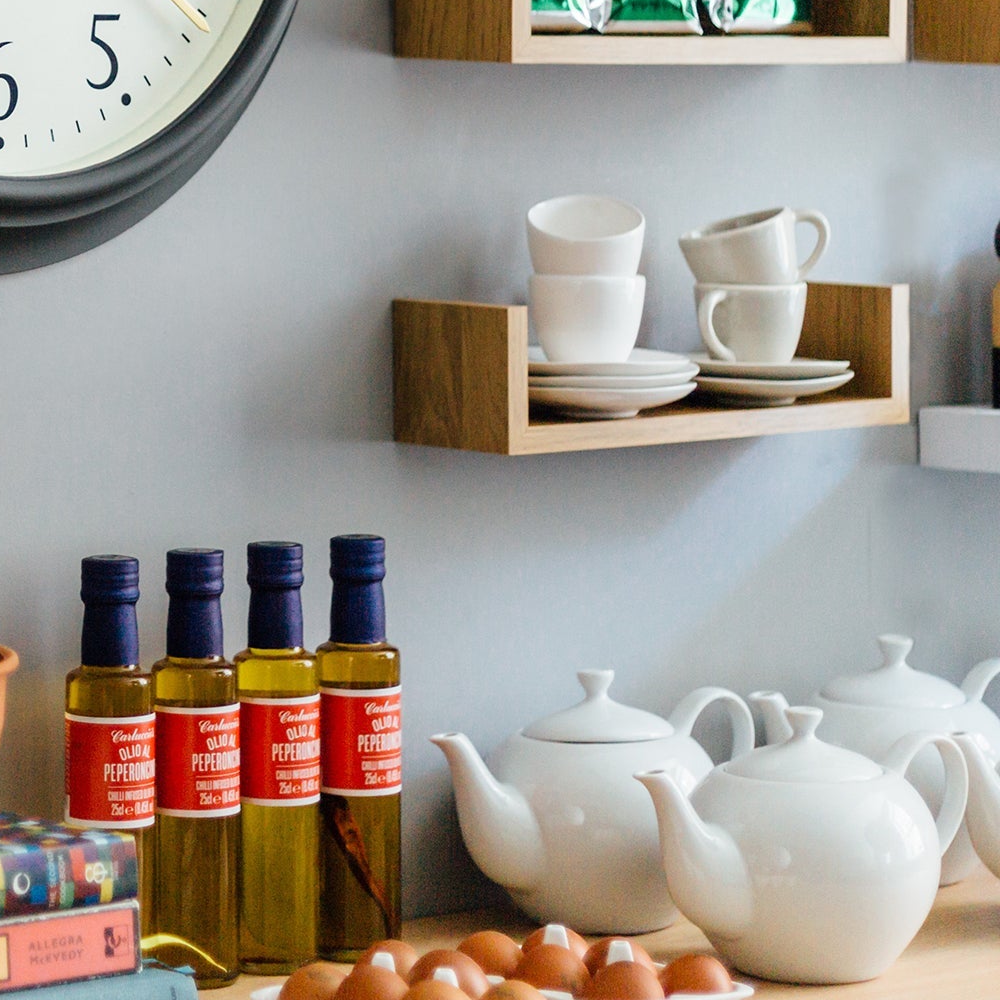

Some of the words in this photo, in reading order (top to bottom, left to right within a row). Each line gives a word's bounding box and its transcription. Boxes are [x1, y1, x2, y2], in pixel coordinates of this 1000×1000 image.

[85, 13, 121, 90] 5
[372, 715, 392, 732] OLIO
[286, 724, 308, 741] OLIO
[206, 734, 228, 750] OLIO
[119, 744, 141, 761] OLIO
[28, 935, 84, 950] ALLEGRA
